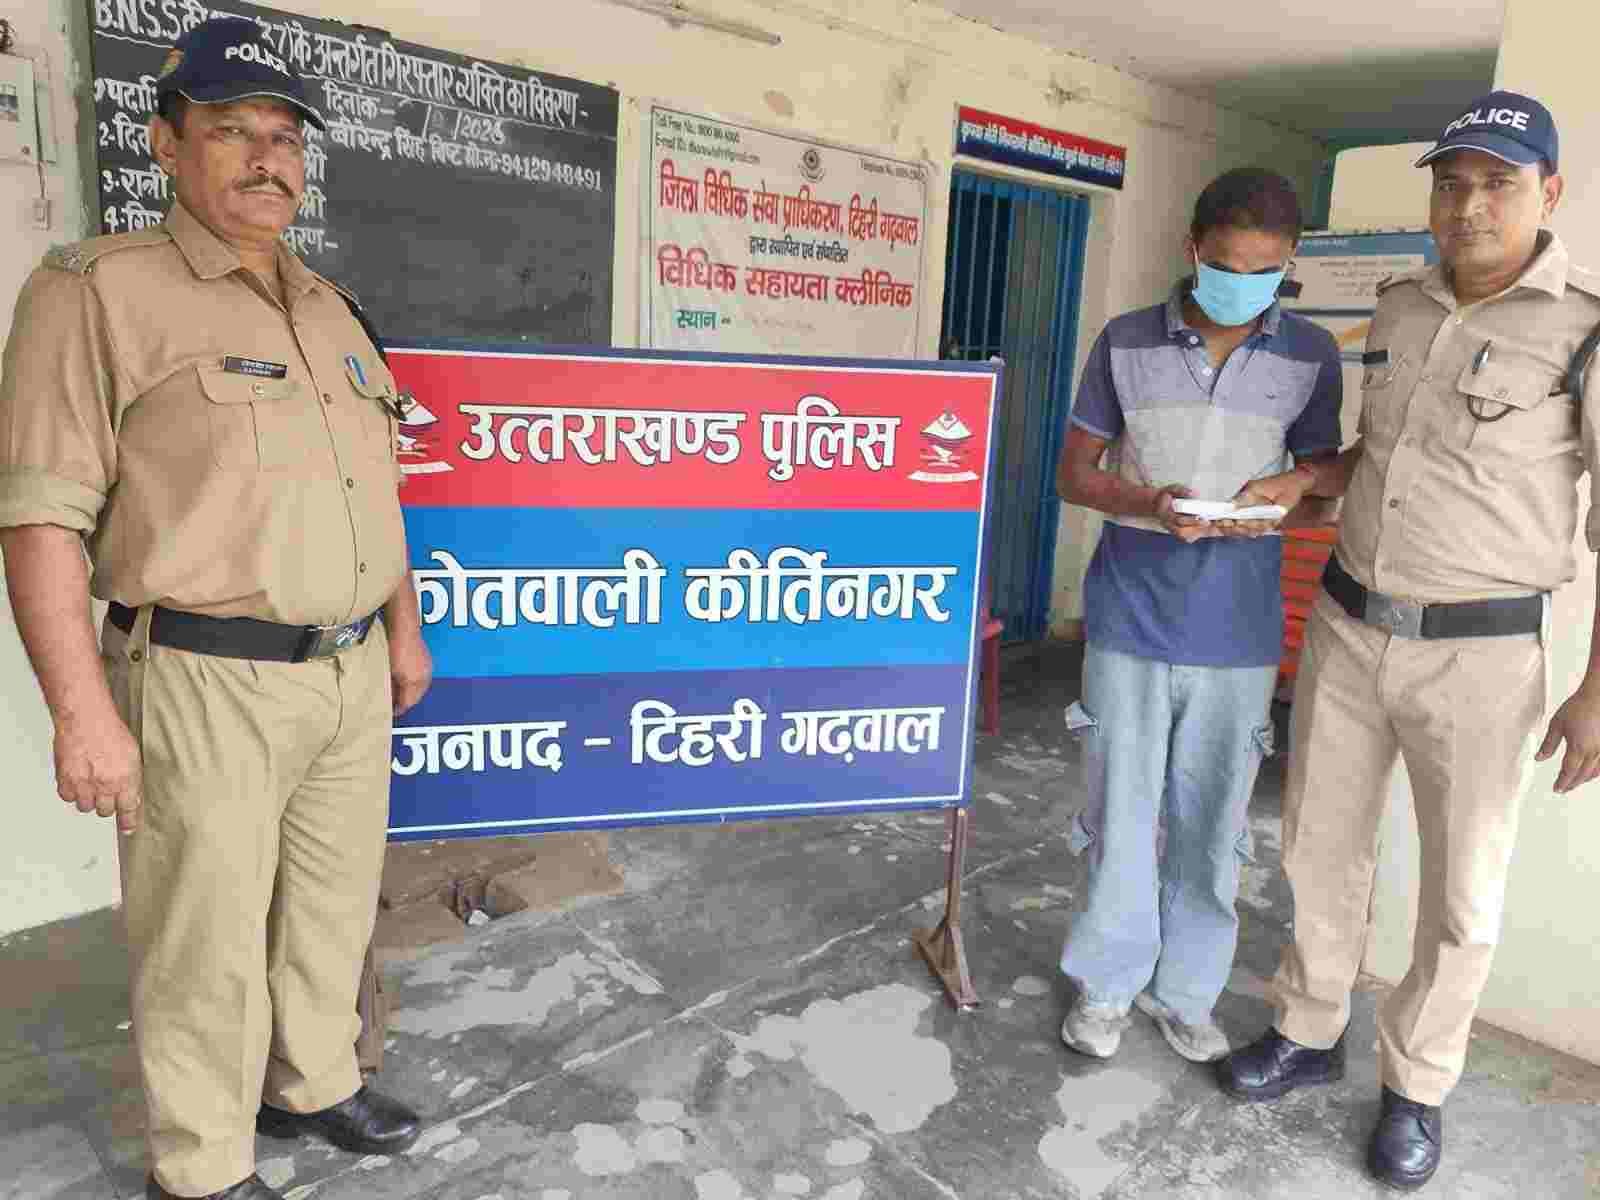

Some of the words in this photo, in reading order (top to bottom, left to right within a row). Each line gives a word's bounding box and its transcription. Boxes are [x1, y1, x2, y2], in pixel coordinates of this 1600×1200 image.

[1444, 107, 1530, 137] POLICE
[660, 158, 698, 213] जिला
[704, 167, 750, 218] विधिक
[751, 179, 780, 224] सेवा
[848, 193, 878, 241] टिहरी
[656, 244, 738, 293] विधिक
[745, 266, 830, 301] सहायता
[835, 268, 914, 308] क्लीनिक
[676, 309, 717, 329] स्थान
[458, 403, 748, 466] उत्तराखण्ड
[760, 395, 902, 481] पुलिस
[683, 546, 958, 626] कीर्तिनगर
[391, 720, 568, 776] जनपद
[630, 698, 768, 767] टिहरी
[780, 705, 946, 764] गढ़वाल
